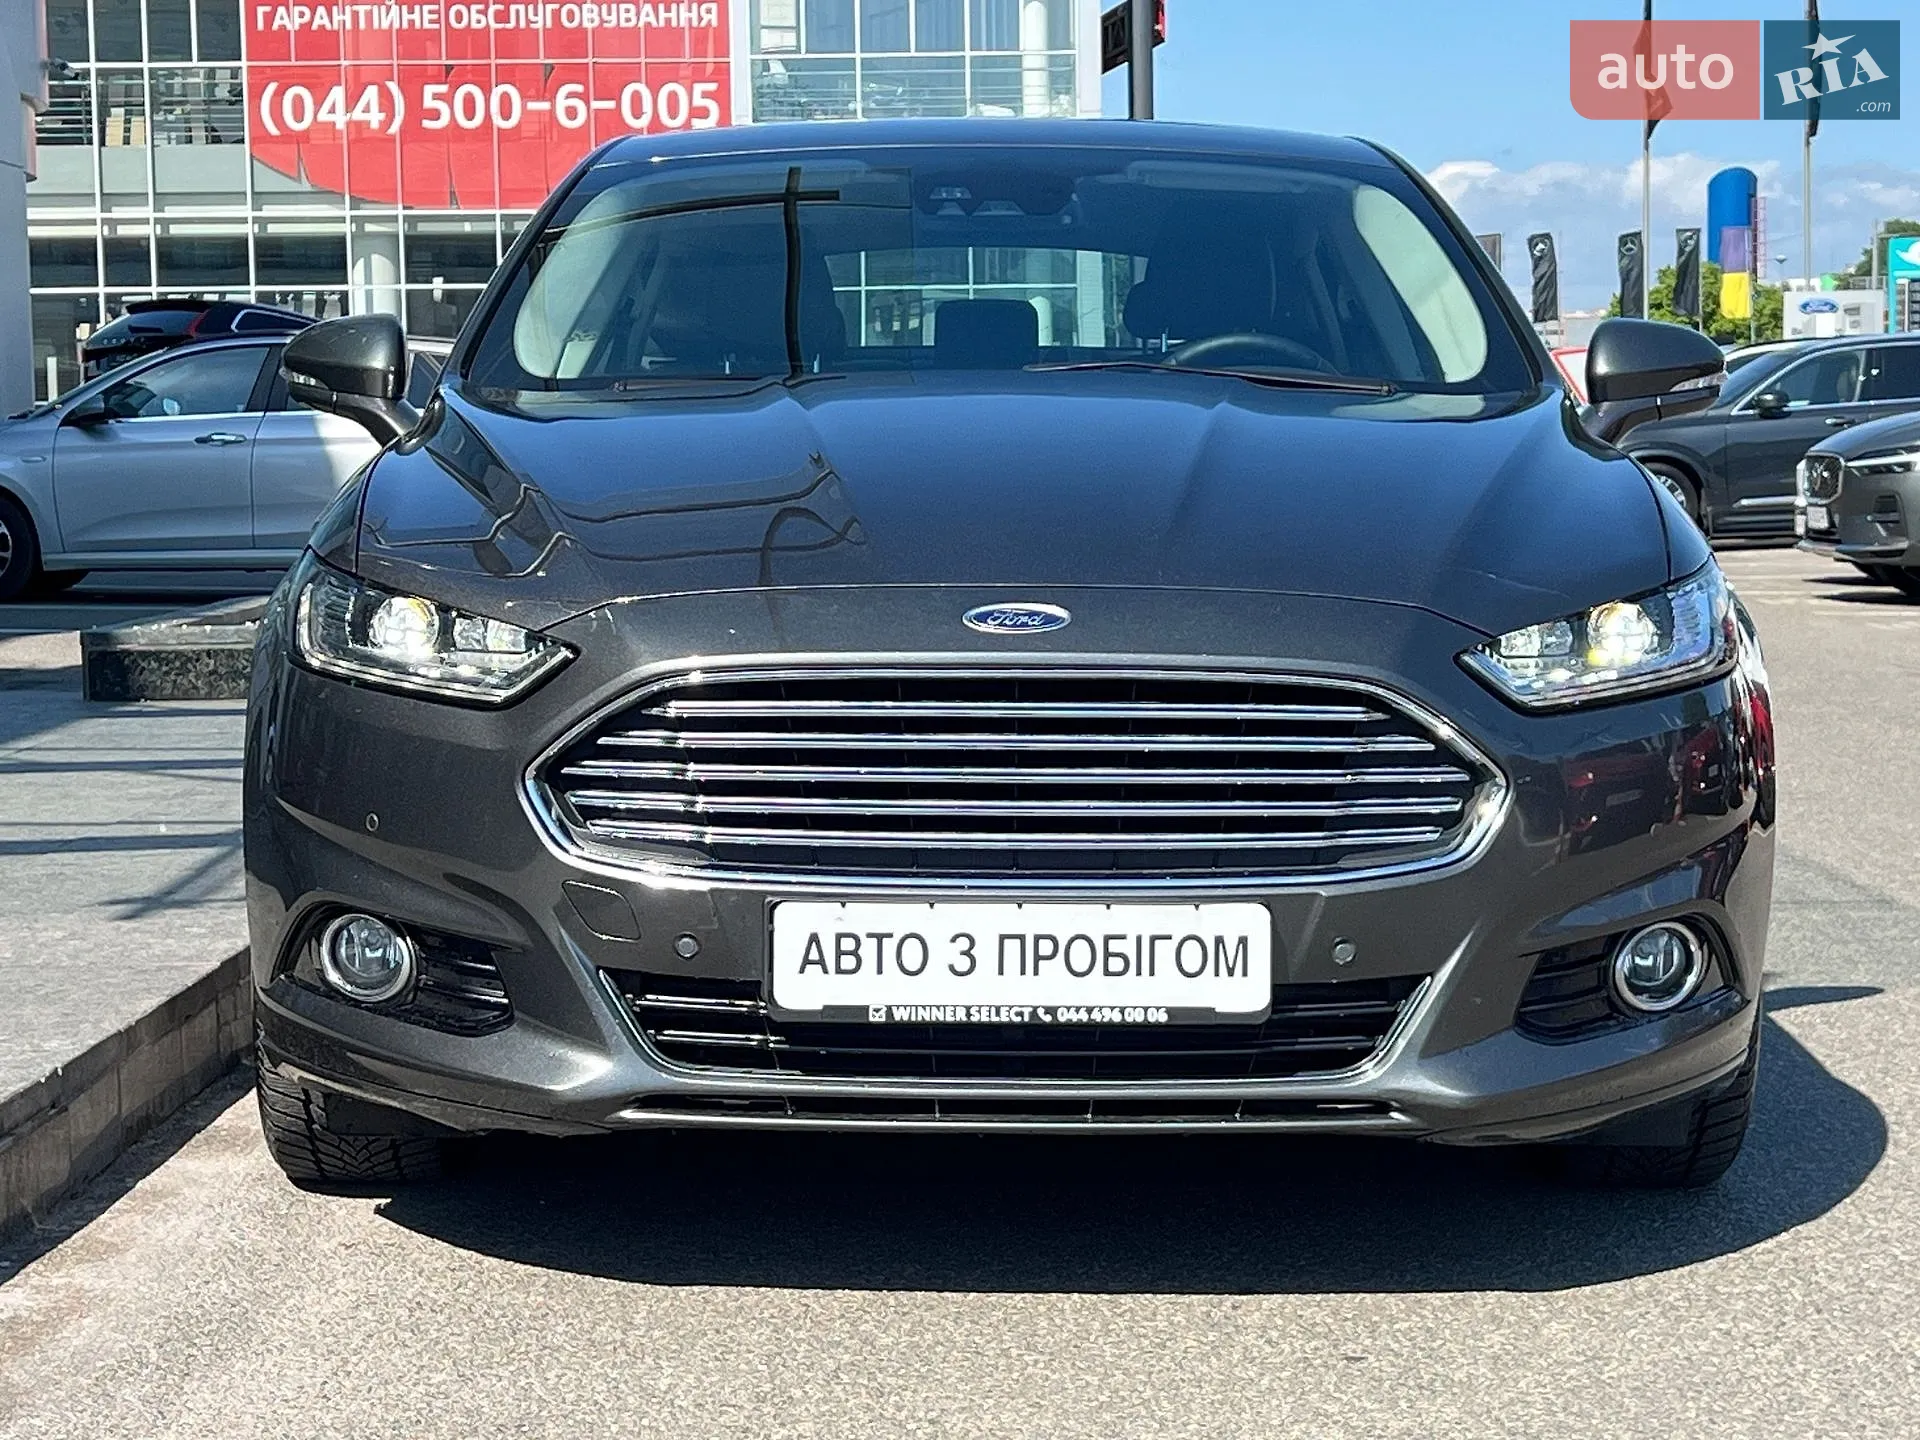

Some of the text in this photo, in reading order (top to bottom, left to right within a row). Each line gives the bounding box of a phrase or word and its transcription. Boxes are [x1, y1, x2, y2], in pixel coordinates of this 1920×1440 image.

[255, 1, 719, 31] ГАРАНТІЙНЕ ОБСЛУГОВУВАННЯ
[260, 80, 720, 136] (044) 500-6-005
[985, 608, 1046, 626] Ford
[798, 932, 930, 977] АВТО
[997, 933, 1249, 978] ПРОБІГОМ
[891, 1006, 967, 1022] WINNER
[969, 1006, 1033, 1022] SELECT
[1056, 1006, 1089, 1022] 044
[1090, 1006, 1123, 1022] 496
[1146, 1006, 1169, 1022] 06
